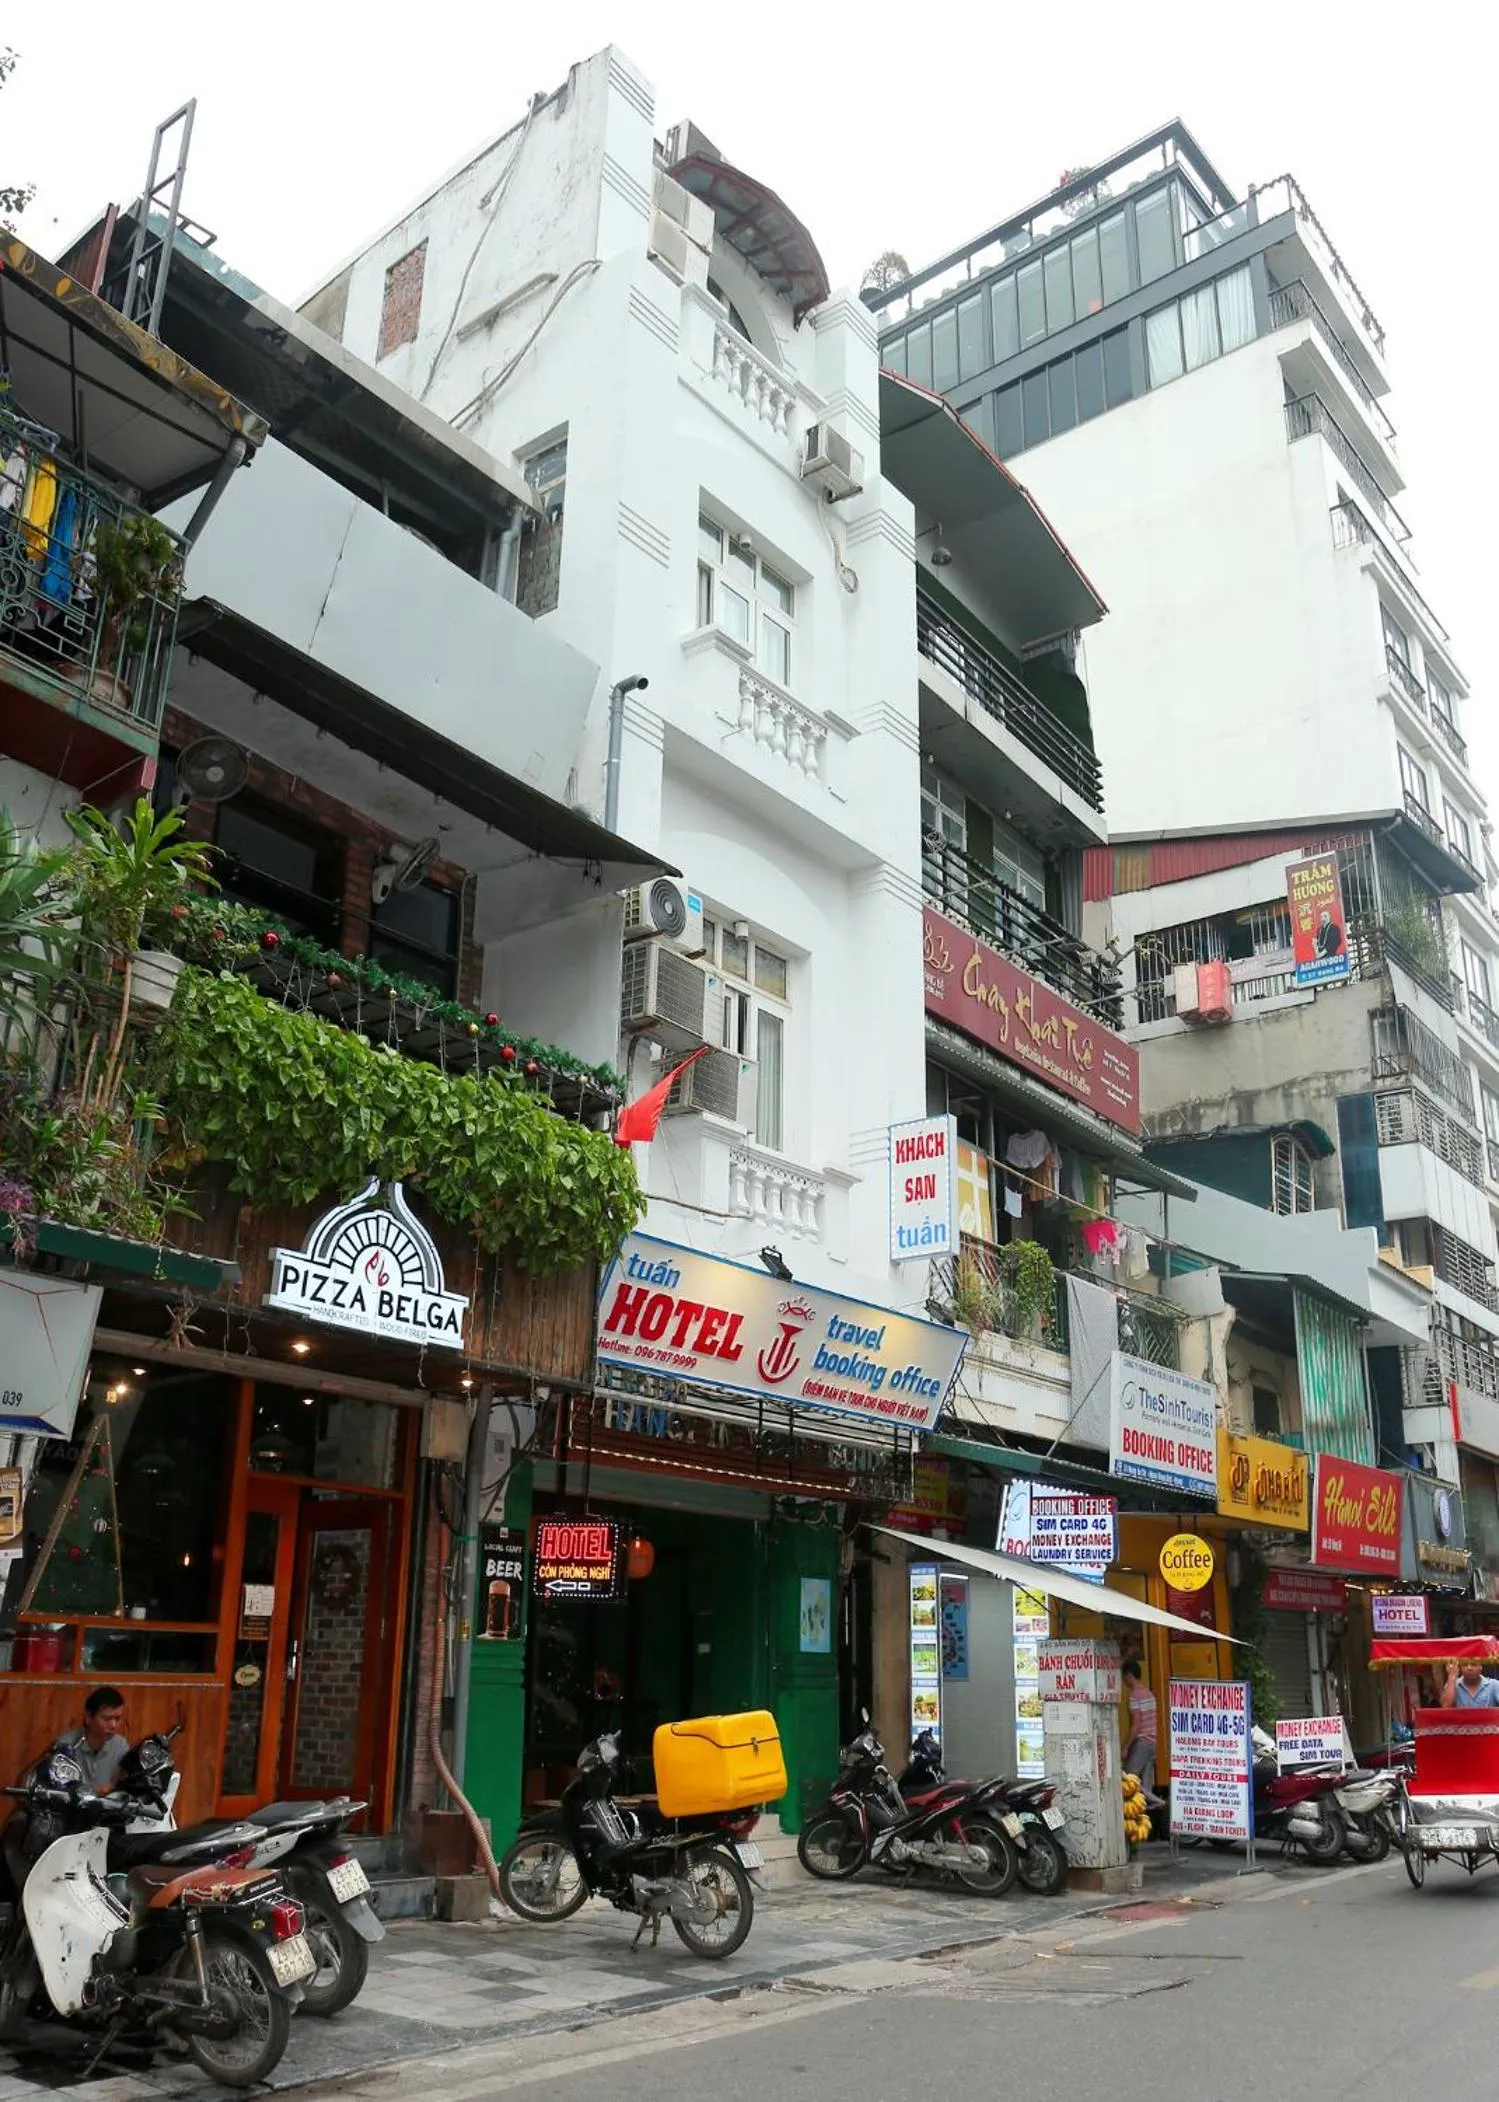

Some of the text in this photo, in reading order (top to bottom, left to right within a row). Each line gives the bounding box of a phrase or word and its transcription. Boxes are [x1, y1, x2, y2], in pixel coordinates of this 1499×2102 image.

[895, 1132, 945, 1164] KHÁCH
[905, 1174, 936, 1205] SẠN
[897, 1215, 946, 1248] tuấn
[628, 1253, 681, 1288] tuấn
[281, 1265, 459, 1334] PIZZA BELGA
[604, 1282, 745, 1361] HOTEL
[827, 1314, 886, 1351] travel
[814, 1343, 940, 1397] booking office
[1123, 1427, 1174, 1464] BOOKING
[1178, 1443, 1213, 1473] OFFICE
[1032, 1498, 1111, 1515] BOOKING OFFICE
[1036, 1518, 1107, 1530] SIM CARD 4G
[540, 1527, 612, 1559] HOTEL
[1032, 1533, 1111, 1546] MONEY EXCHANGE
[1032, 1549, 1111, 1560] LAUNDRY SERVICE
[1163, 1549, 1211, 1569] Coffee
[486, 1558, 523, 1582] BEER
[1379, 1609, 1420, 1620] HOTEL
[1039, 1652, 1062, 1671] BÁNH
[1065, 1648, 1093, 1669] CHUỐI
[1056, 1671, 1075, 1690] RÁN
[1170, 1684, 1244, 1710] MONEY EXCHANGE
[1172, 1711, 1188, 1732] SIM
[1191, 1713, 1214, 1734] CARD
[1277, 1718, 1341, 1738] MONEY EXCHANGE
[1279, 1739, 1323, 1751] FREE DATA
[1299, 1749, 1343, 1760] SIM TOUR
[1179, 1771, 1238, 1781] DAILY TOURS
